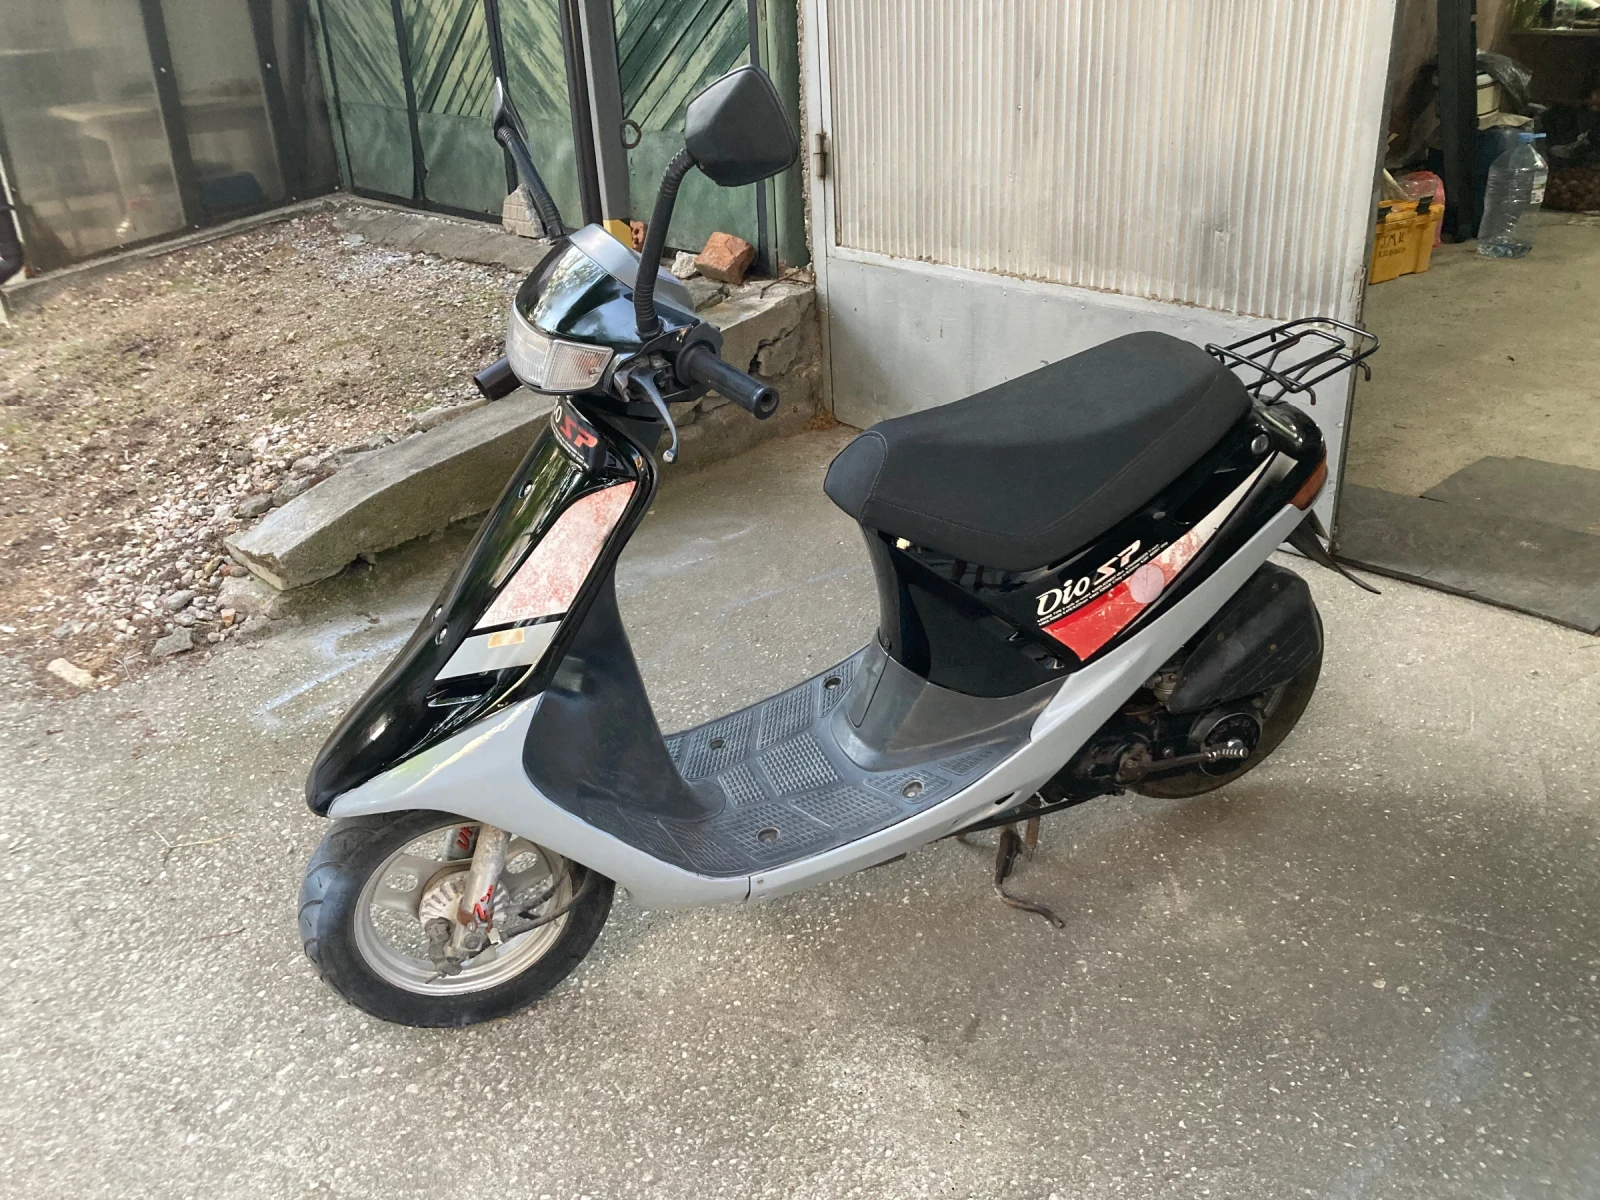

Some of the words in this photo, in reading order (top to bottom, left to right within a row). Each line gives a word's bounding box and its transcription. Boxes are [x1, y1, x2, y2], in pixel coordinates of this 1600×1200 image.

[560, 414, 598, 448] SP
[1036, 576, 1090, 616] Dio
[1093, 540, 1141, 586] SP
[491, 605, 536, 621] HONDA
